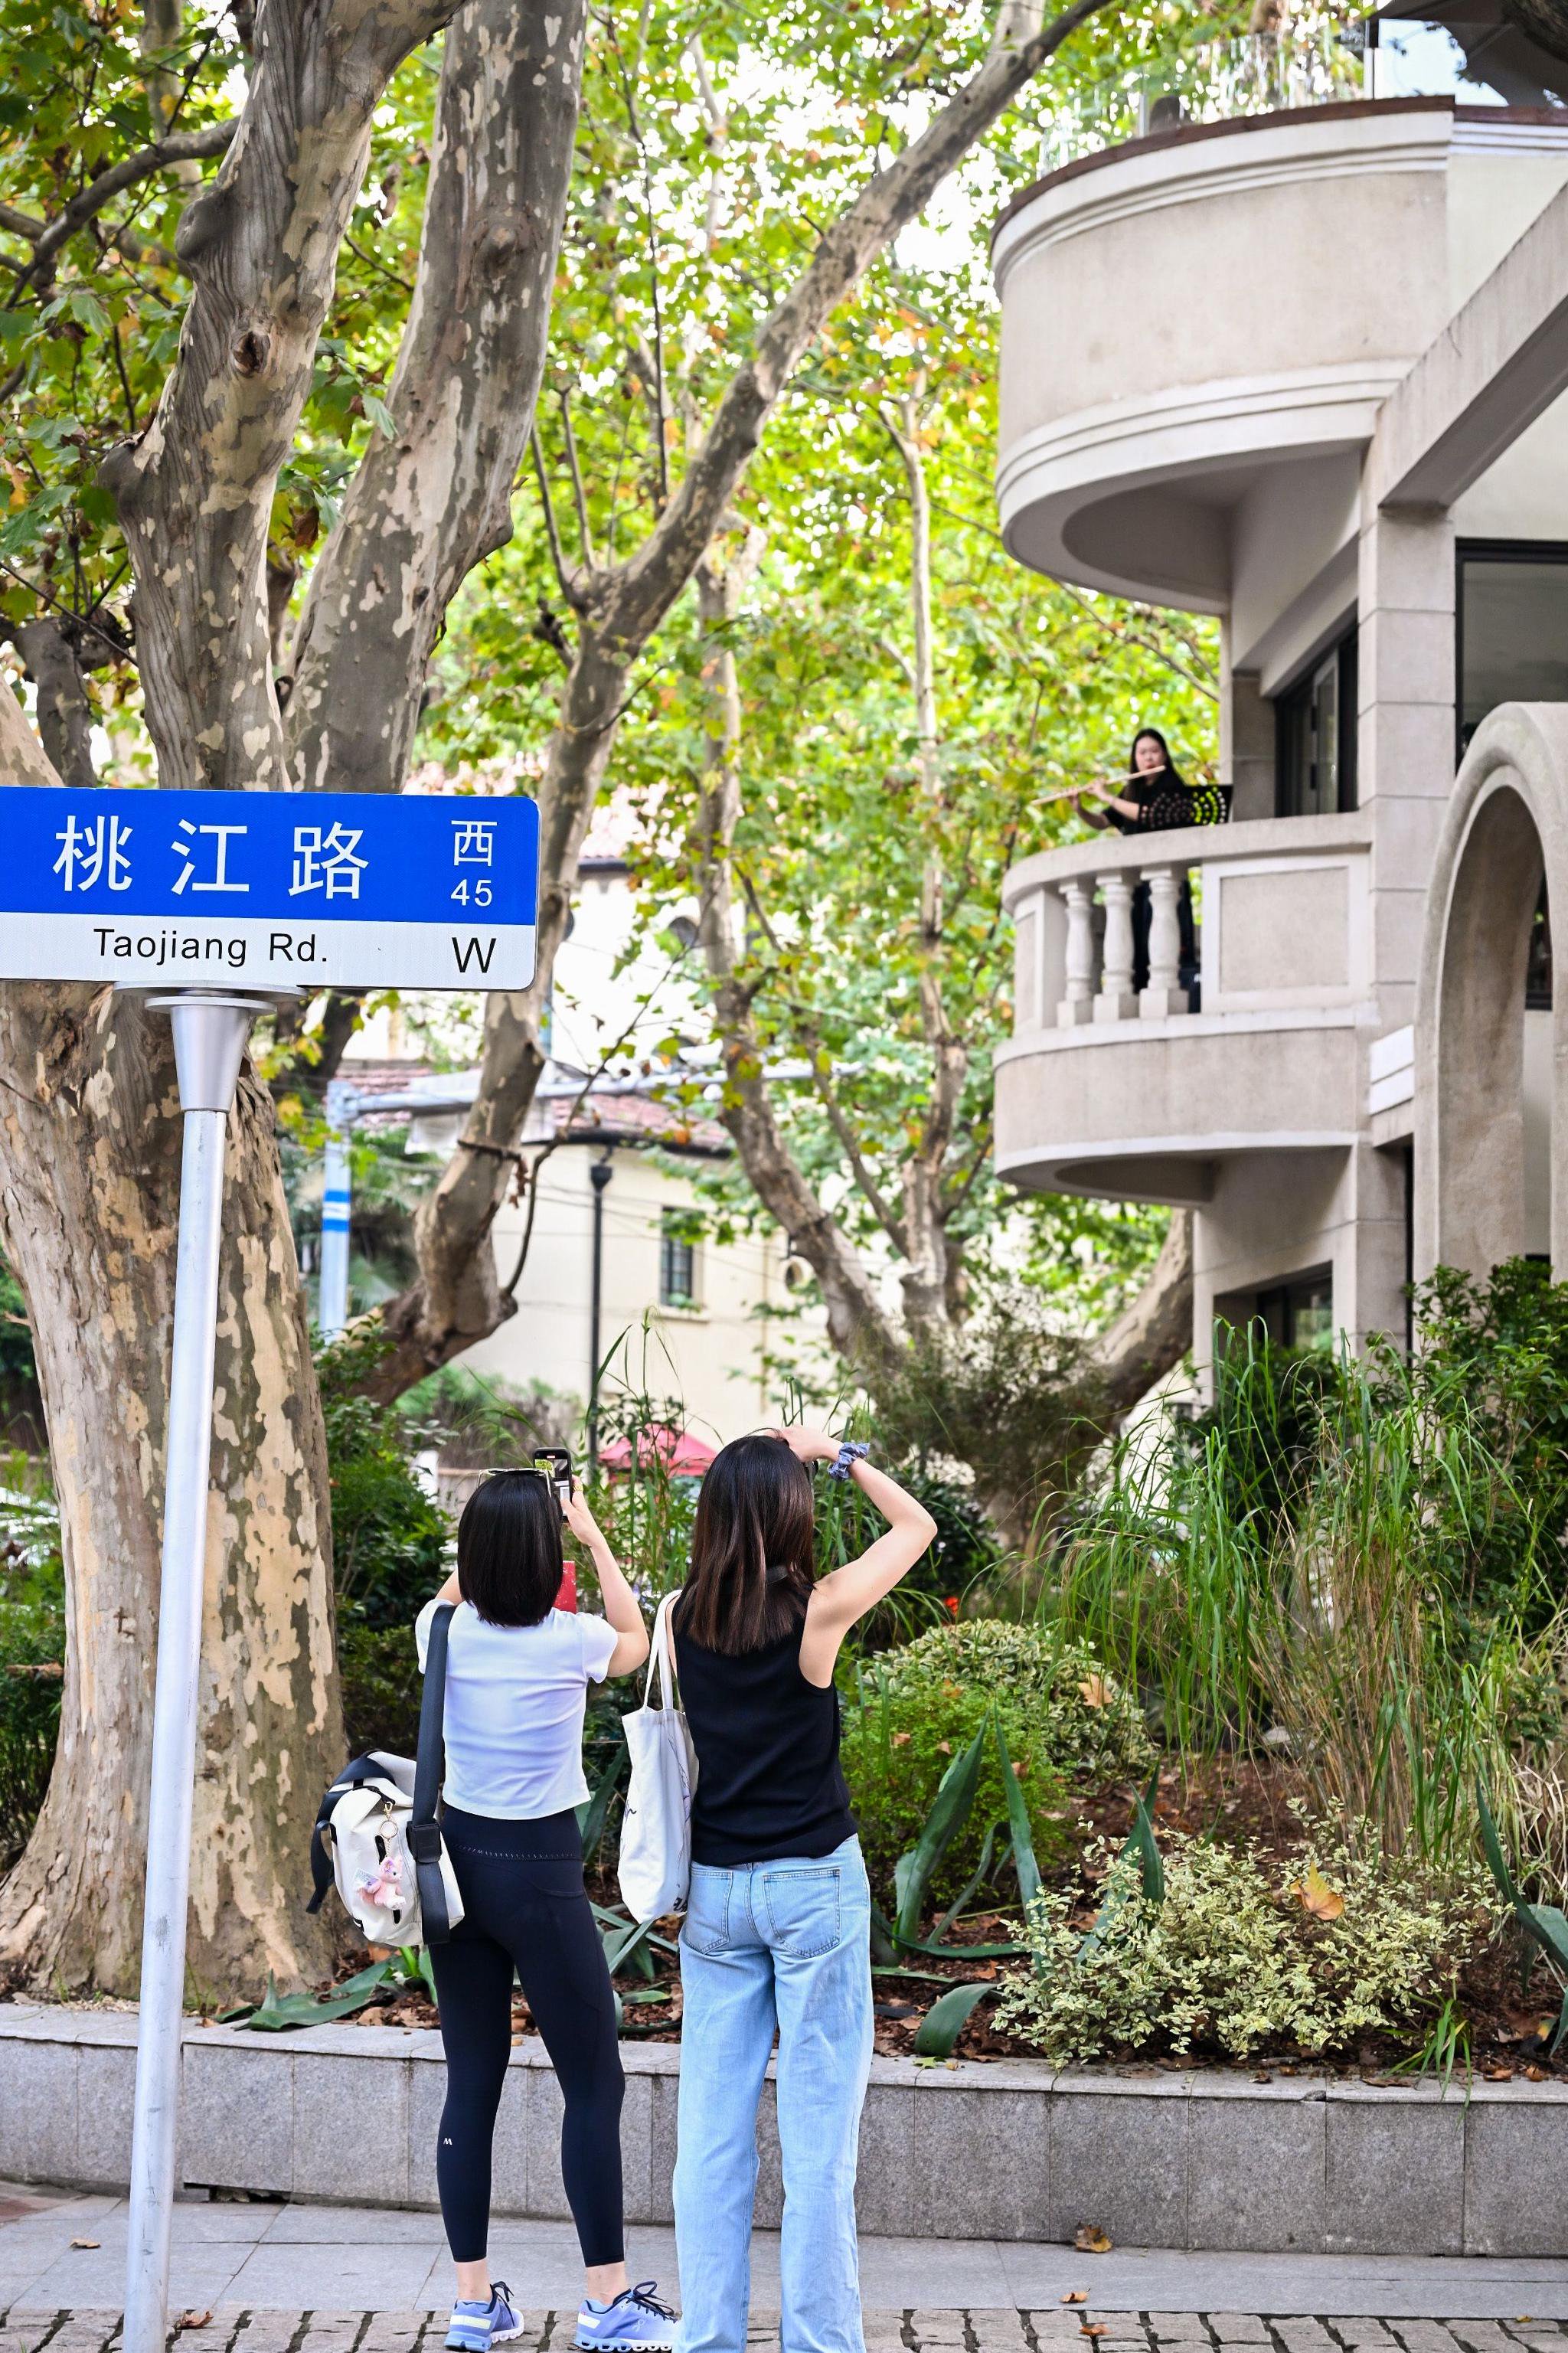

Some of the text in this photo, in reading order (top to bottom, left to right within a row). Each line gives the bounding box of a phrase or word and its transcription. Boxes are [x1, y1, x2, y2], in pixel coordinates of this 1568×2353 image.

[53, 815, 369, 900] 桃江路
[452, 820, 498, 867] 西
[450, 879, 493, 907] 45
[93, 928, 328, 967] Taojiang Rd.
[452, 936, 497, 973] W
